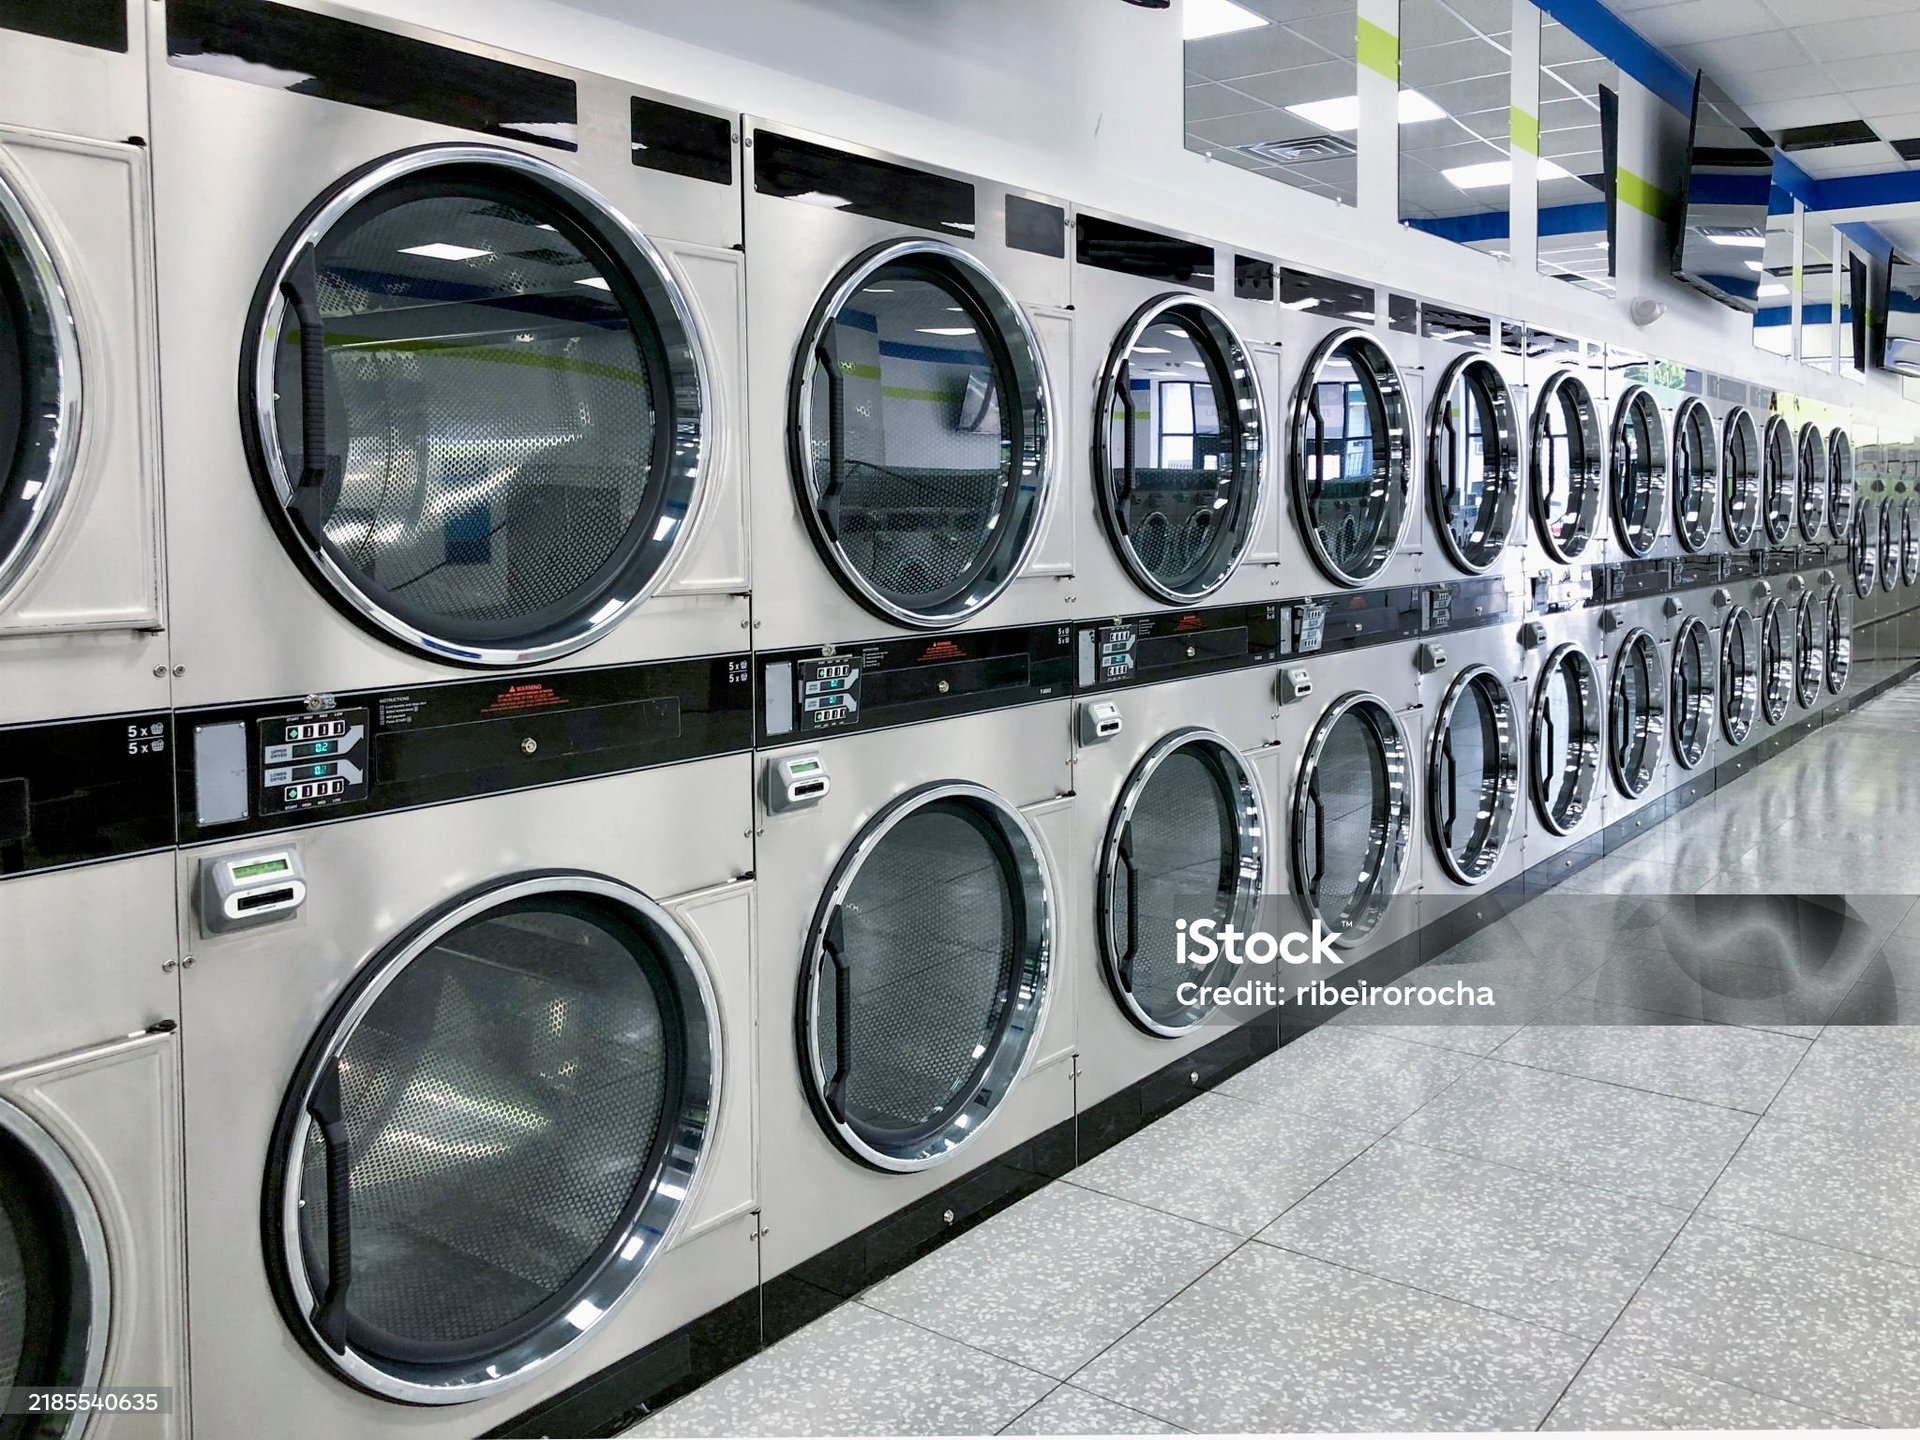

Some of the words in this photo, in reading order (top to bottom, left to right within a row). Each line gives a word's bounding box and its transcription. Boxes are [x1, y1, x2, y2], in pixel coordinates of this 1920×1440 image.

[729, 662, 735, 671] 5
[729, 674, 735, 683] 5
[516, 683, 542, 691] WARNING
[128, 725, 137, 738] 5
[140, 728, 148, 736] x
[128, 742, 138, 755] 5
[141, 745, 149, 753] x
